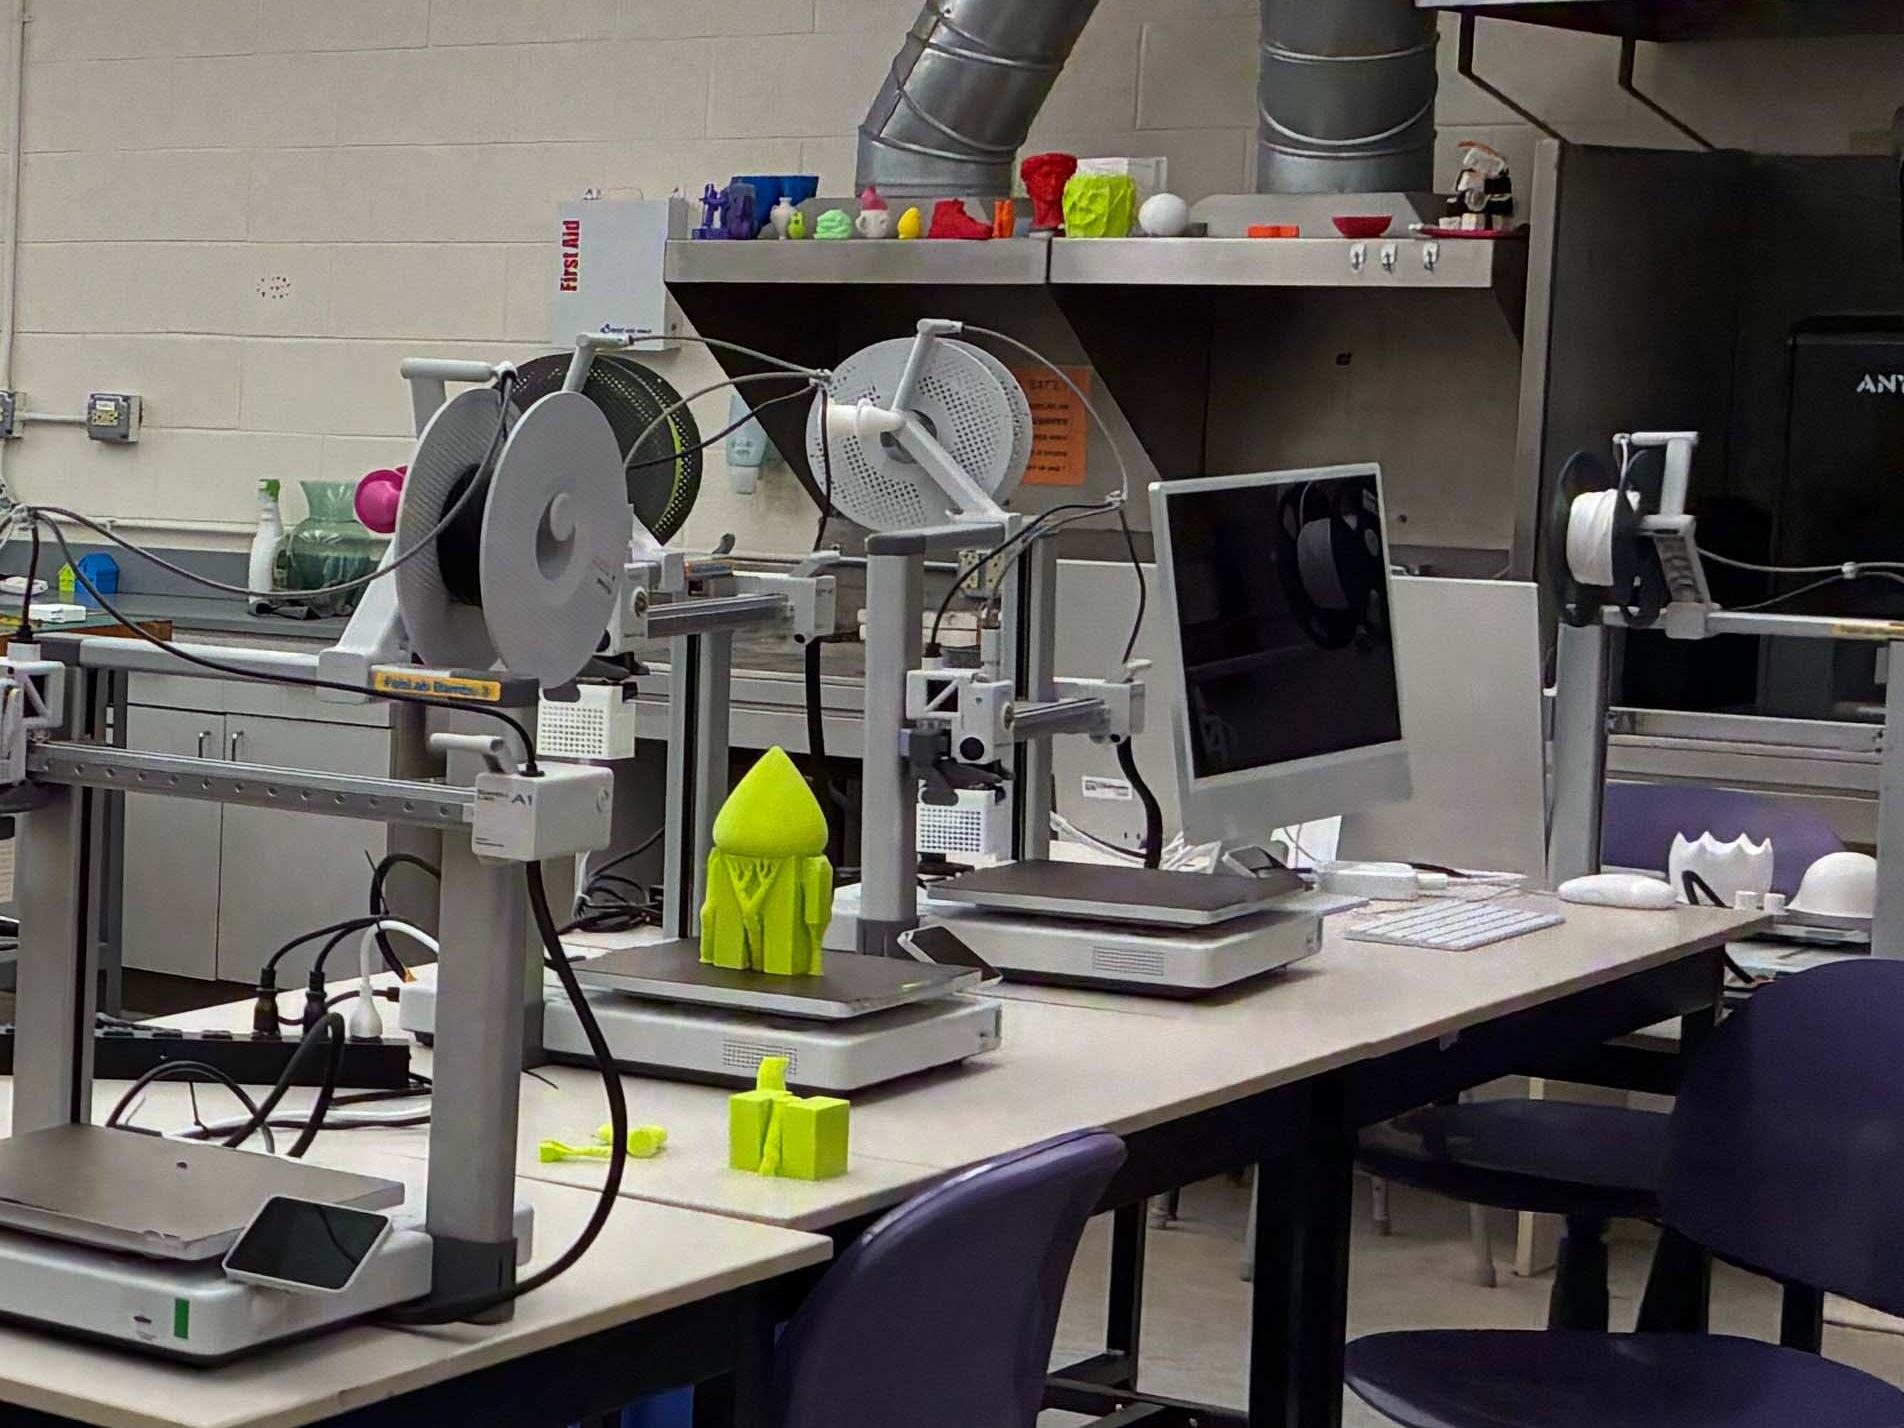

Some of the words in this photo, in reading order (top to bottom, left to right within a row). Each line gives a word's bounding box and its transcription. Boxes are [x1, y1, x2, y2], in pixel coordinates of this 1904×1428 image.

[562, 220, 580, 249] Aid
[560, 252, 579, 291] First
[511, 793, 533, 807] A1
